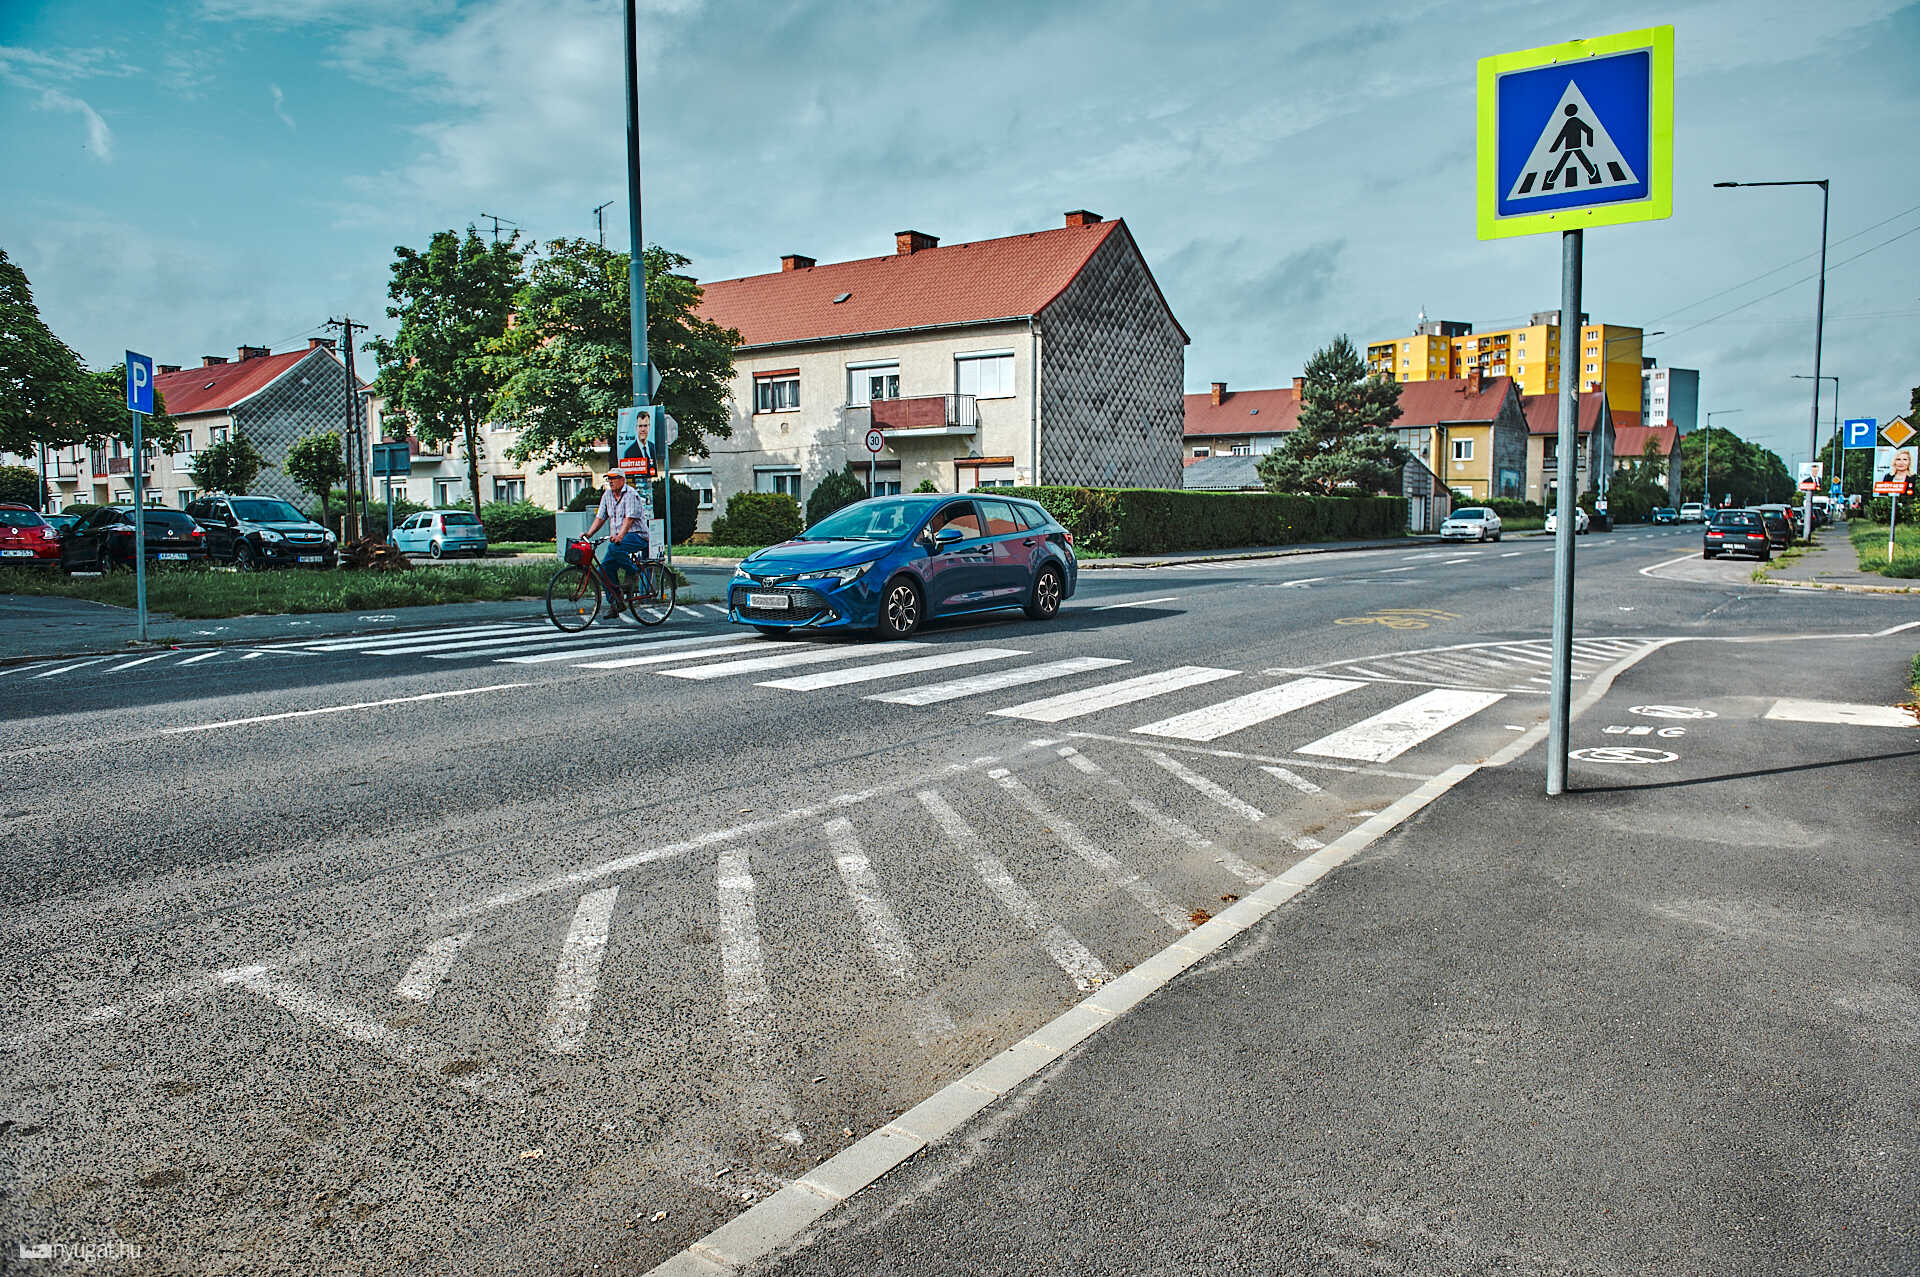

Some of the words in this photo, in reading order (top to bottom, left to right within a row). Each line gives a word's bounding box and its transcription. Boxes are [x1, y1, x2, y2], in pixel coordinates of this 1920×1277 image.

[133, 361, 147, 403] P
[870, 436, 879, 446] 30
[1851, 423, 1869, 445] P
